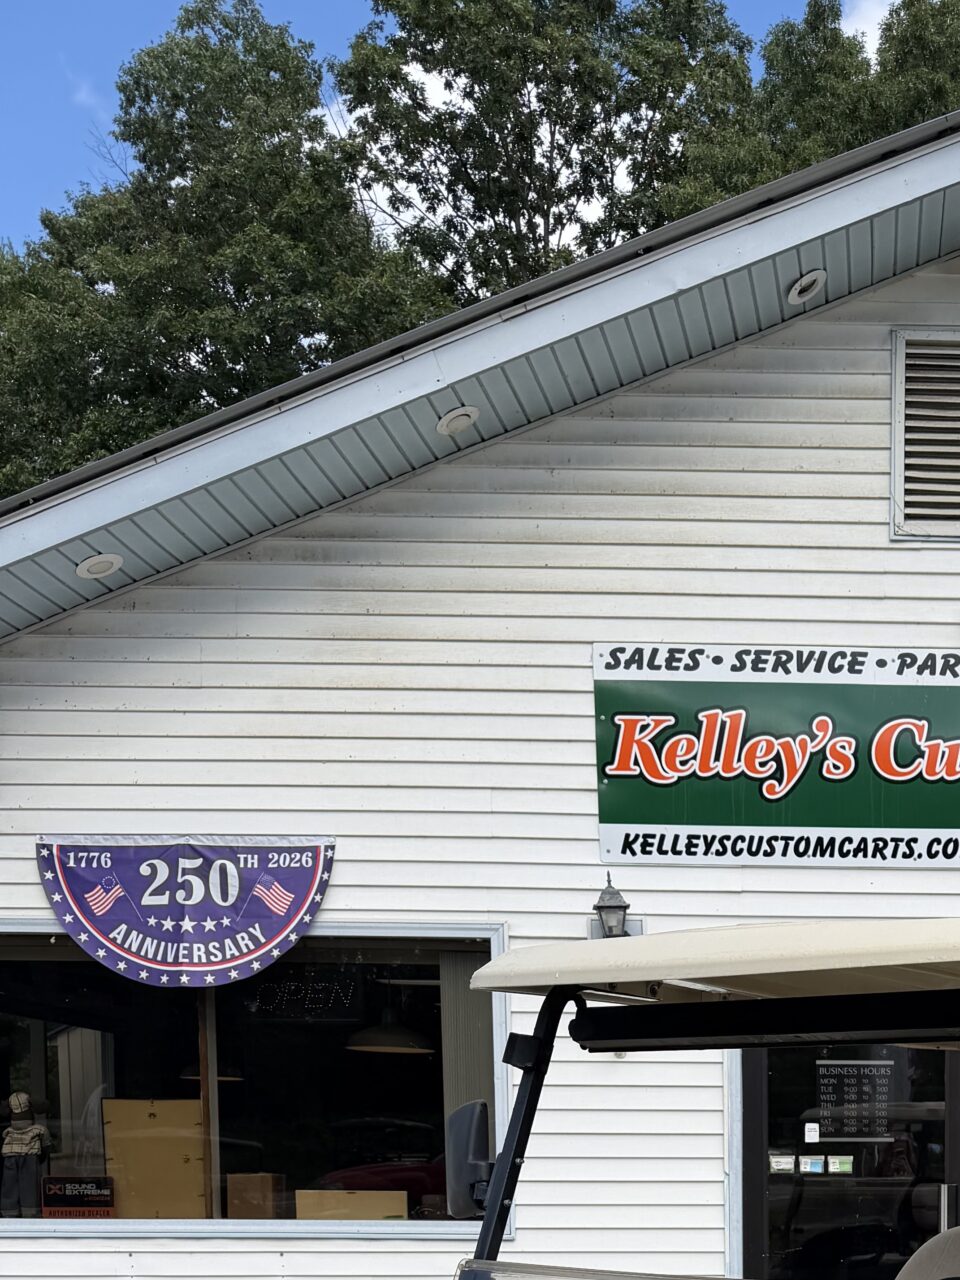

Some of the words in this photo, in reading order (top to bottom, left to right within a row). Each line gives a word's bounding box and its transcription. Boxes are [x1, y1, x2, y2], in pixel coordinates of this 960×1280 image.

[605, 647, 705, 671] SALES
[730, 649, 868, 675] SERVICE
[605, 708, 856, 800] Kelley's
[67, 852, 112, 868] 1776
[268, 852, 313, 868] 2026
[108, 922, 267, 963] ANNIVERSARY
[257, 982, 354, 1010] OPEN
[819, 1067, 857, 1075] BUSINESS
[860, 1067, 891, 1075] HOURS
